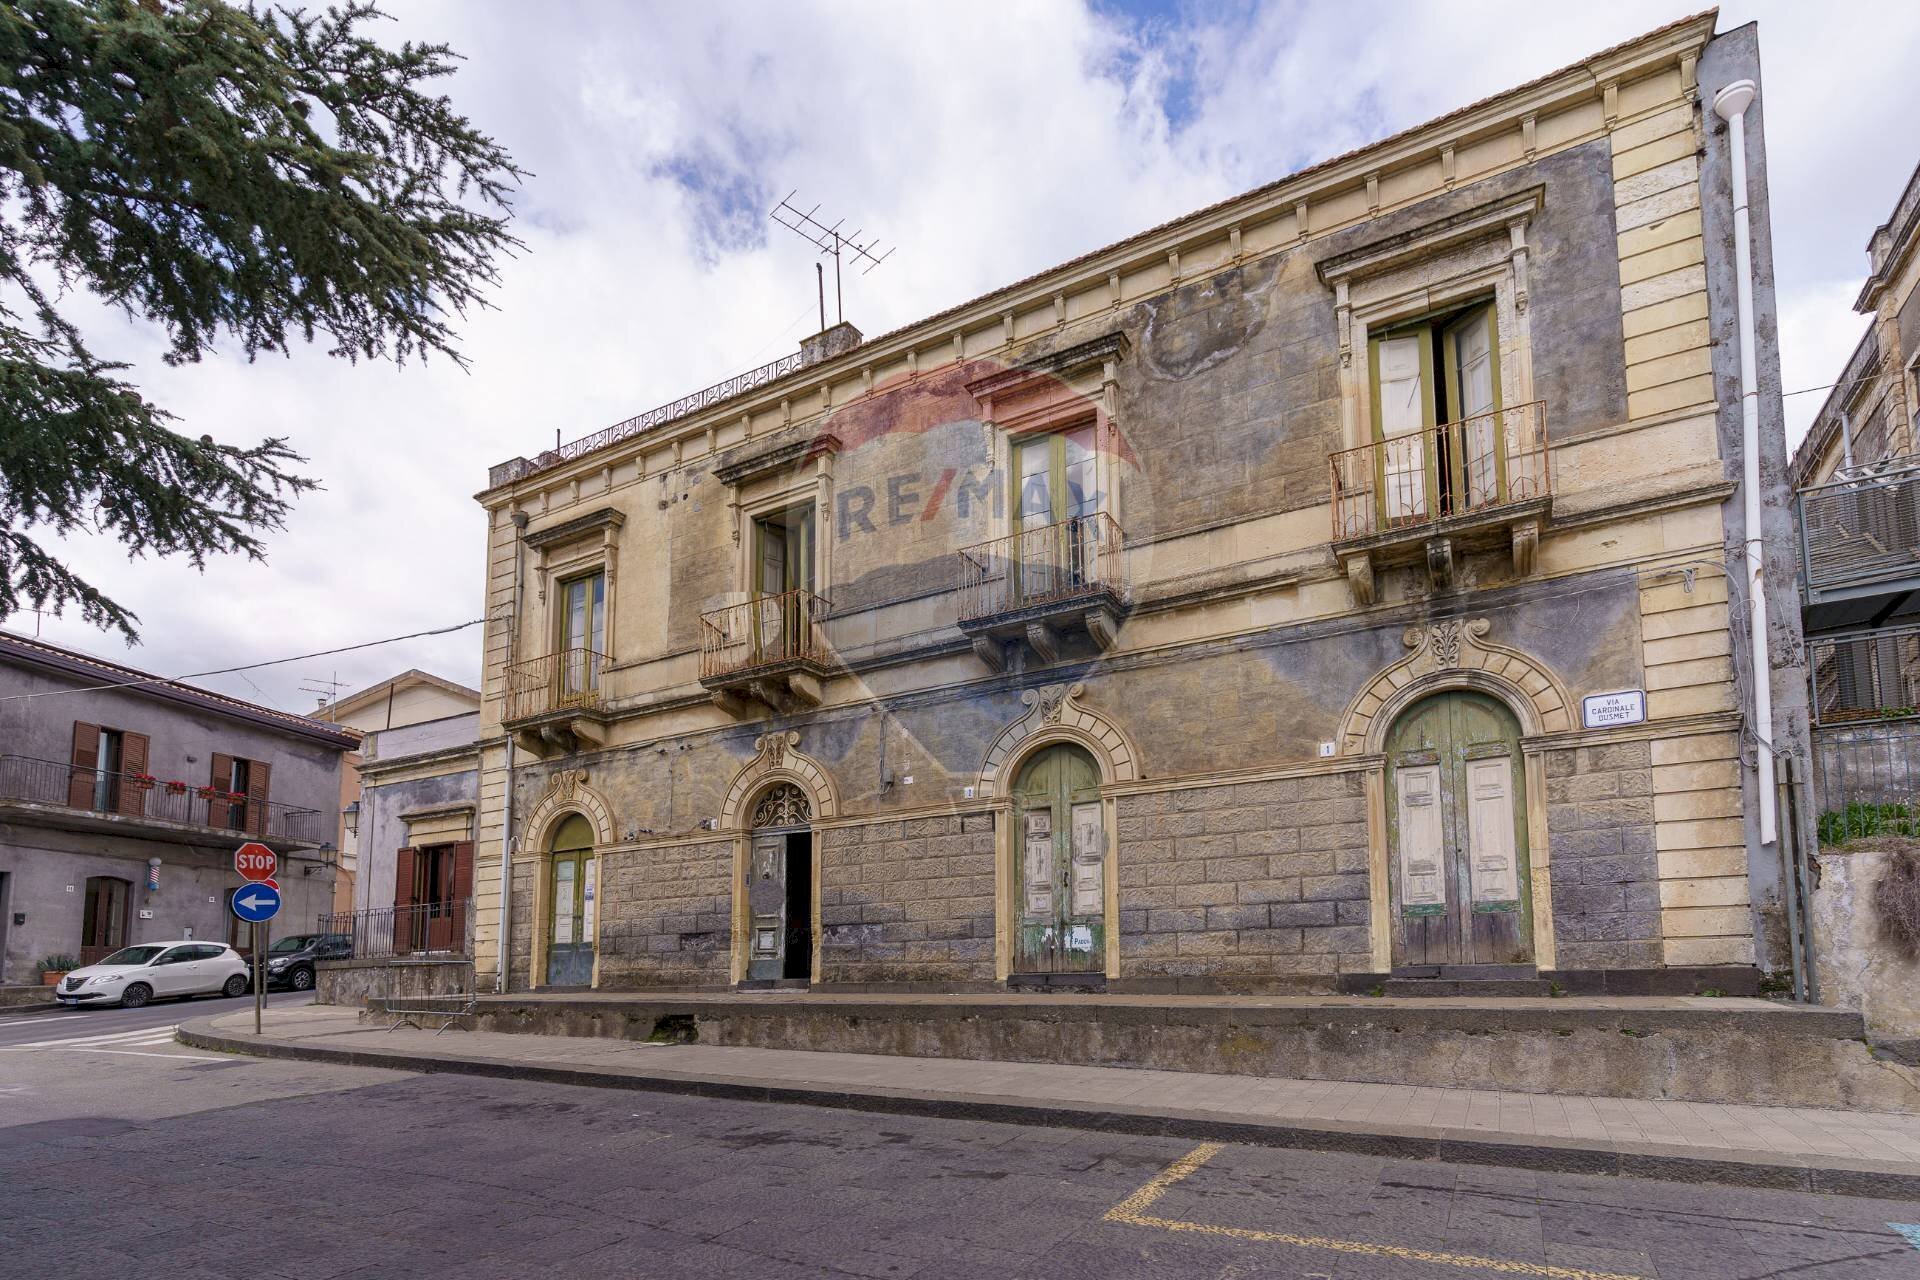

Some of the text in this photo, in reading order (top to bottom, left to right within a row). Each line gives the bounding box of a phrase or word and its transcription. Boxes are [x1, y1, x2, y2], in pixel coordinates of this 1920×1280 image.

[1606, 698, 1620, 706] VIA
[1591, 703, 1636, 715] CARDINALE
[238, 854, 274, 870] STOP
